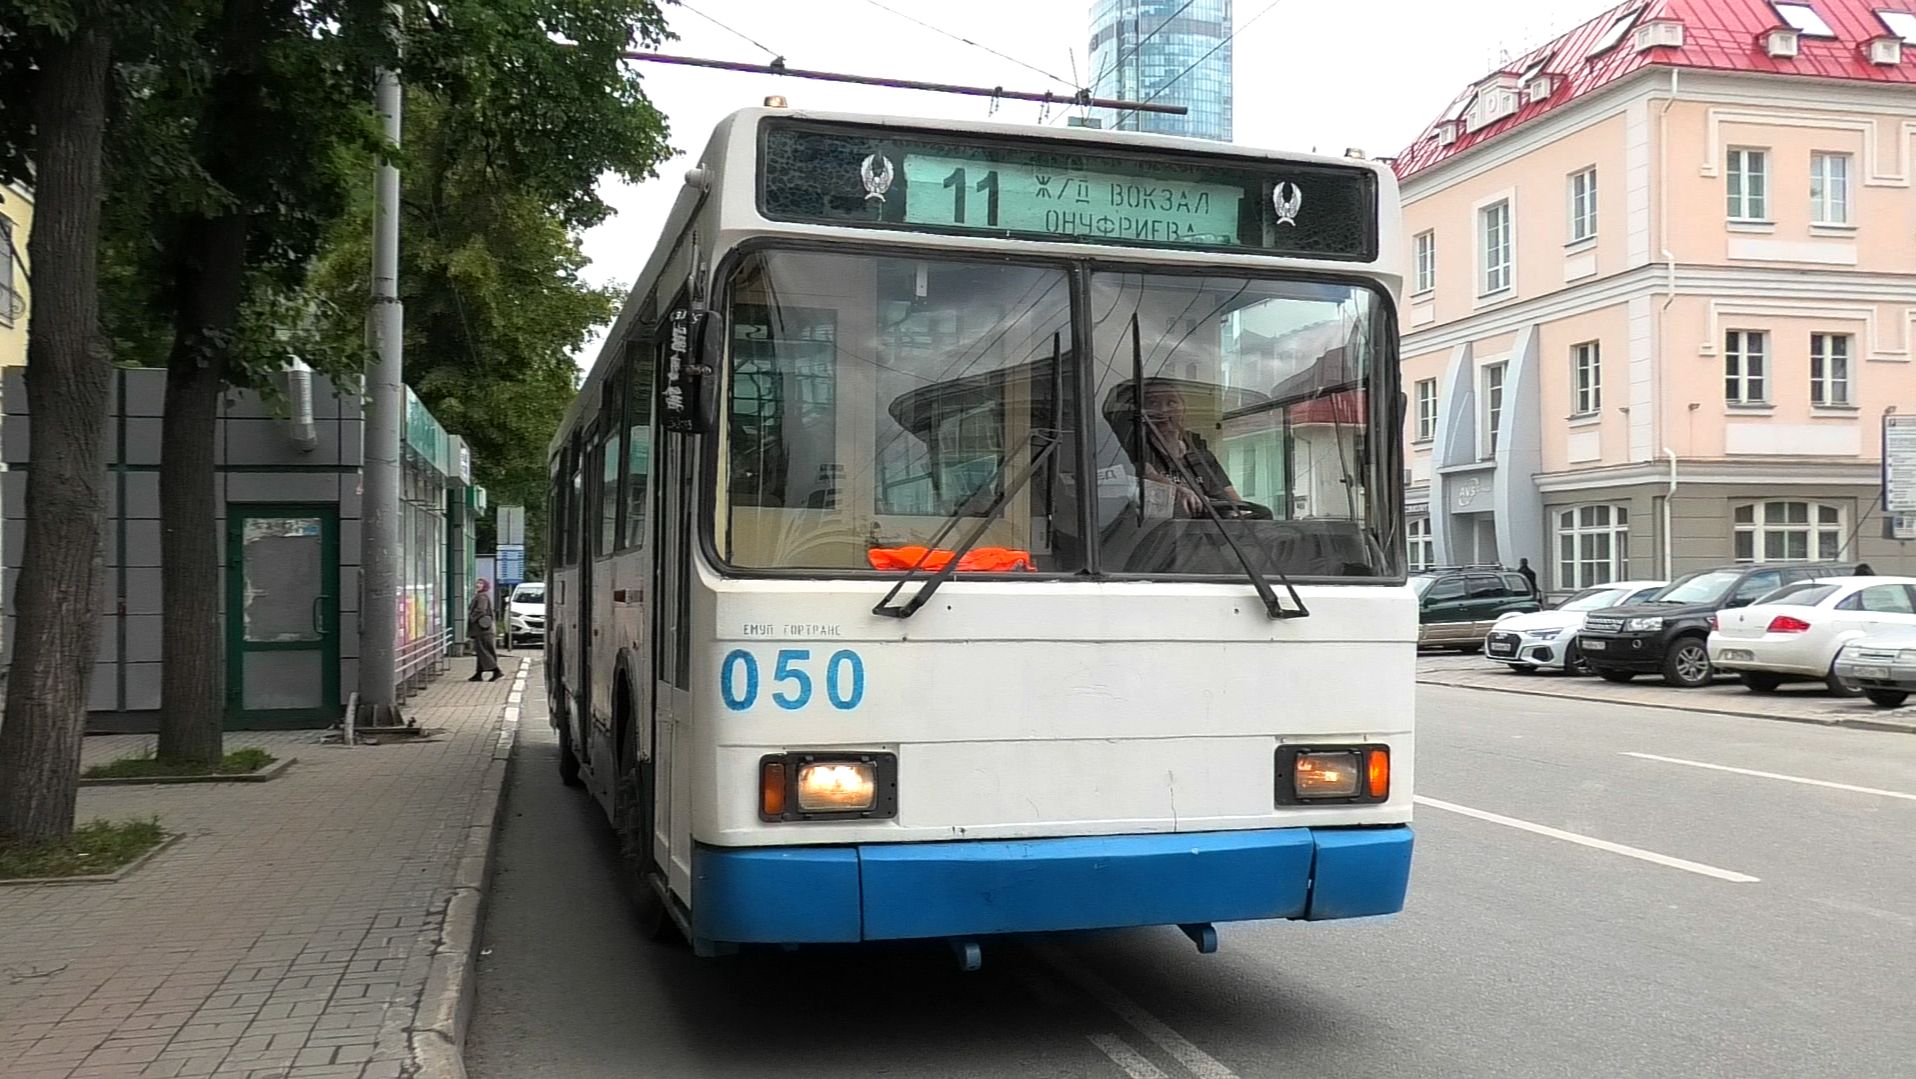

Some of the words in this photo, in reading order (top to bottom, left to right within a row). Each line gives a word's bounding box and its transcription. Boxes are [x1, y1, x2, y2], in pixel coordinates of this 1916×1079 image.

[943, 167, 998, 227] 11
[1110, 182, 1210, 214] ВОКЗАЛ
[743, 624, 774, 636] ЕМУП
[783, 624, 841, 636] ГОРТРАНС
[720, 648, 865, 711] 050
